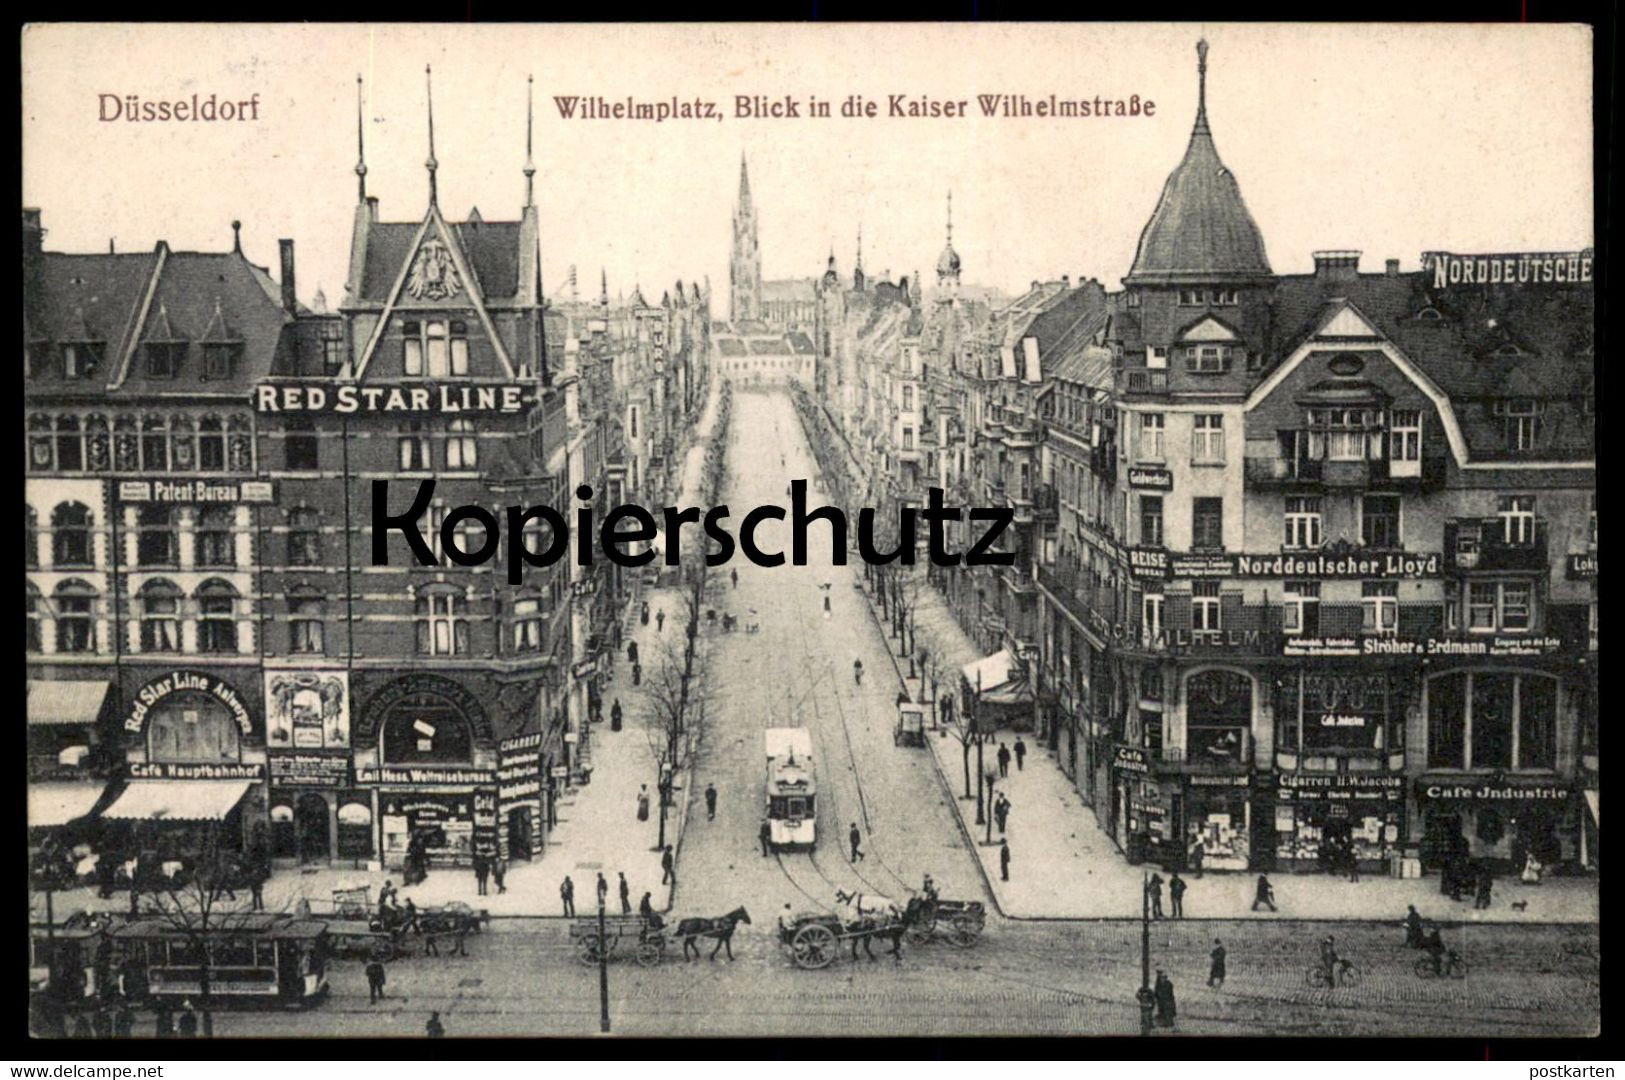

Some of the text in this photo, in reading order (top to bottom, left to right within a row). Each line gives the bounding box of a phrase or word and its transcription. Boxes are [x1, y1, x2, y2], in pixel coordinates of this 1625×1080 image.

[1434, 255, 1592, 289] NORDDEUTSCHE
[259, 386, 521, 412] RED STAR LINE
[1130, 551, 1167, 569] REISE
[1239, 556, 1379, 575] Norddeutscher
[1386, 556, 1436, 577] Lloyd
[1427, 638, 1487, 655] Erdmann
[123, 700, 148, 733] Red
[139, 680, 172, 706] Star
[172, 671, 209, 691] Line
[168, 764, 261, 779] Hauptbahnhof
